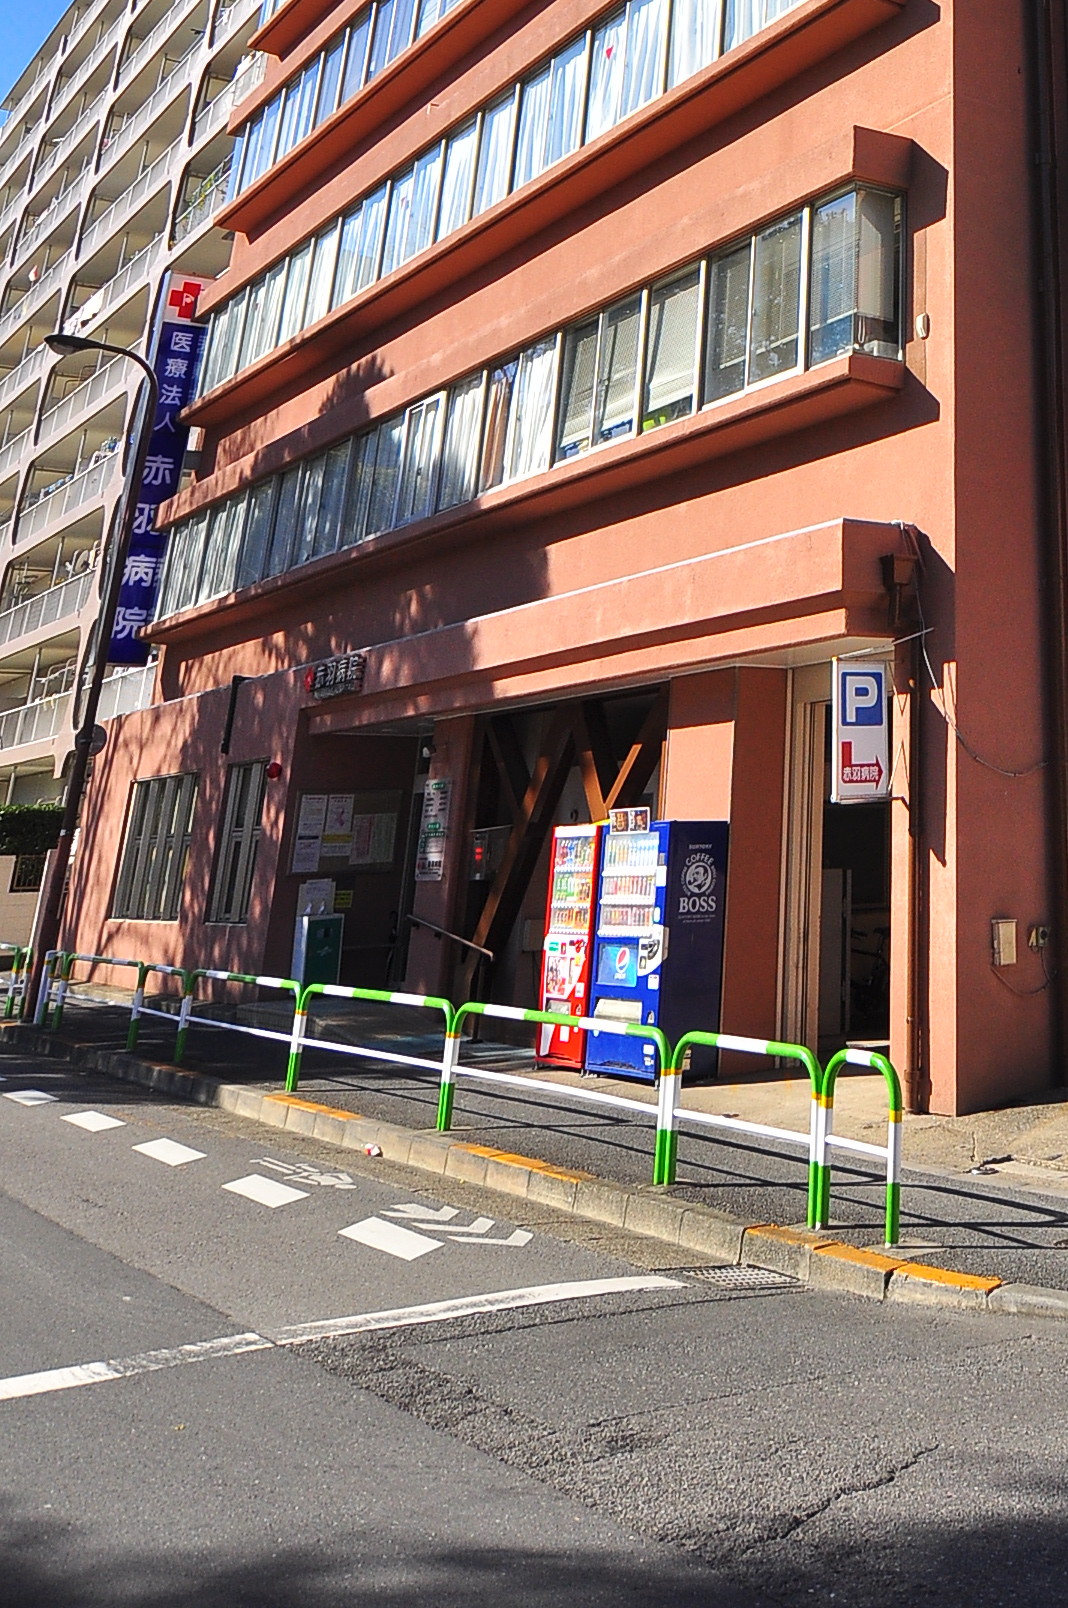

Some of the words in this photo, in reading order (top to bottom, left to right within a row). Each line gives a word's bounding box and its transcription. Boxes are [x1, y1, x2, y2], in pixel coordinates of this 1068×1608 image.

[153, 331, 193, 432] 医療法人
[111, 454, 174, 640] 赤羽病院
[846, 676, 877, 722] P
[843, 766, 878, 781] 赤羽病院
[685, 852, 714, 866] COFFEE
[678, 896, 717, 913] BOSS
